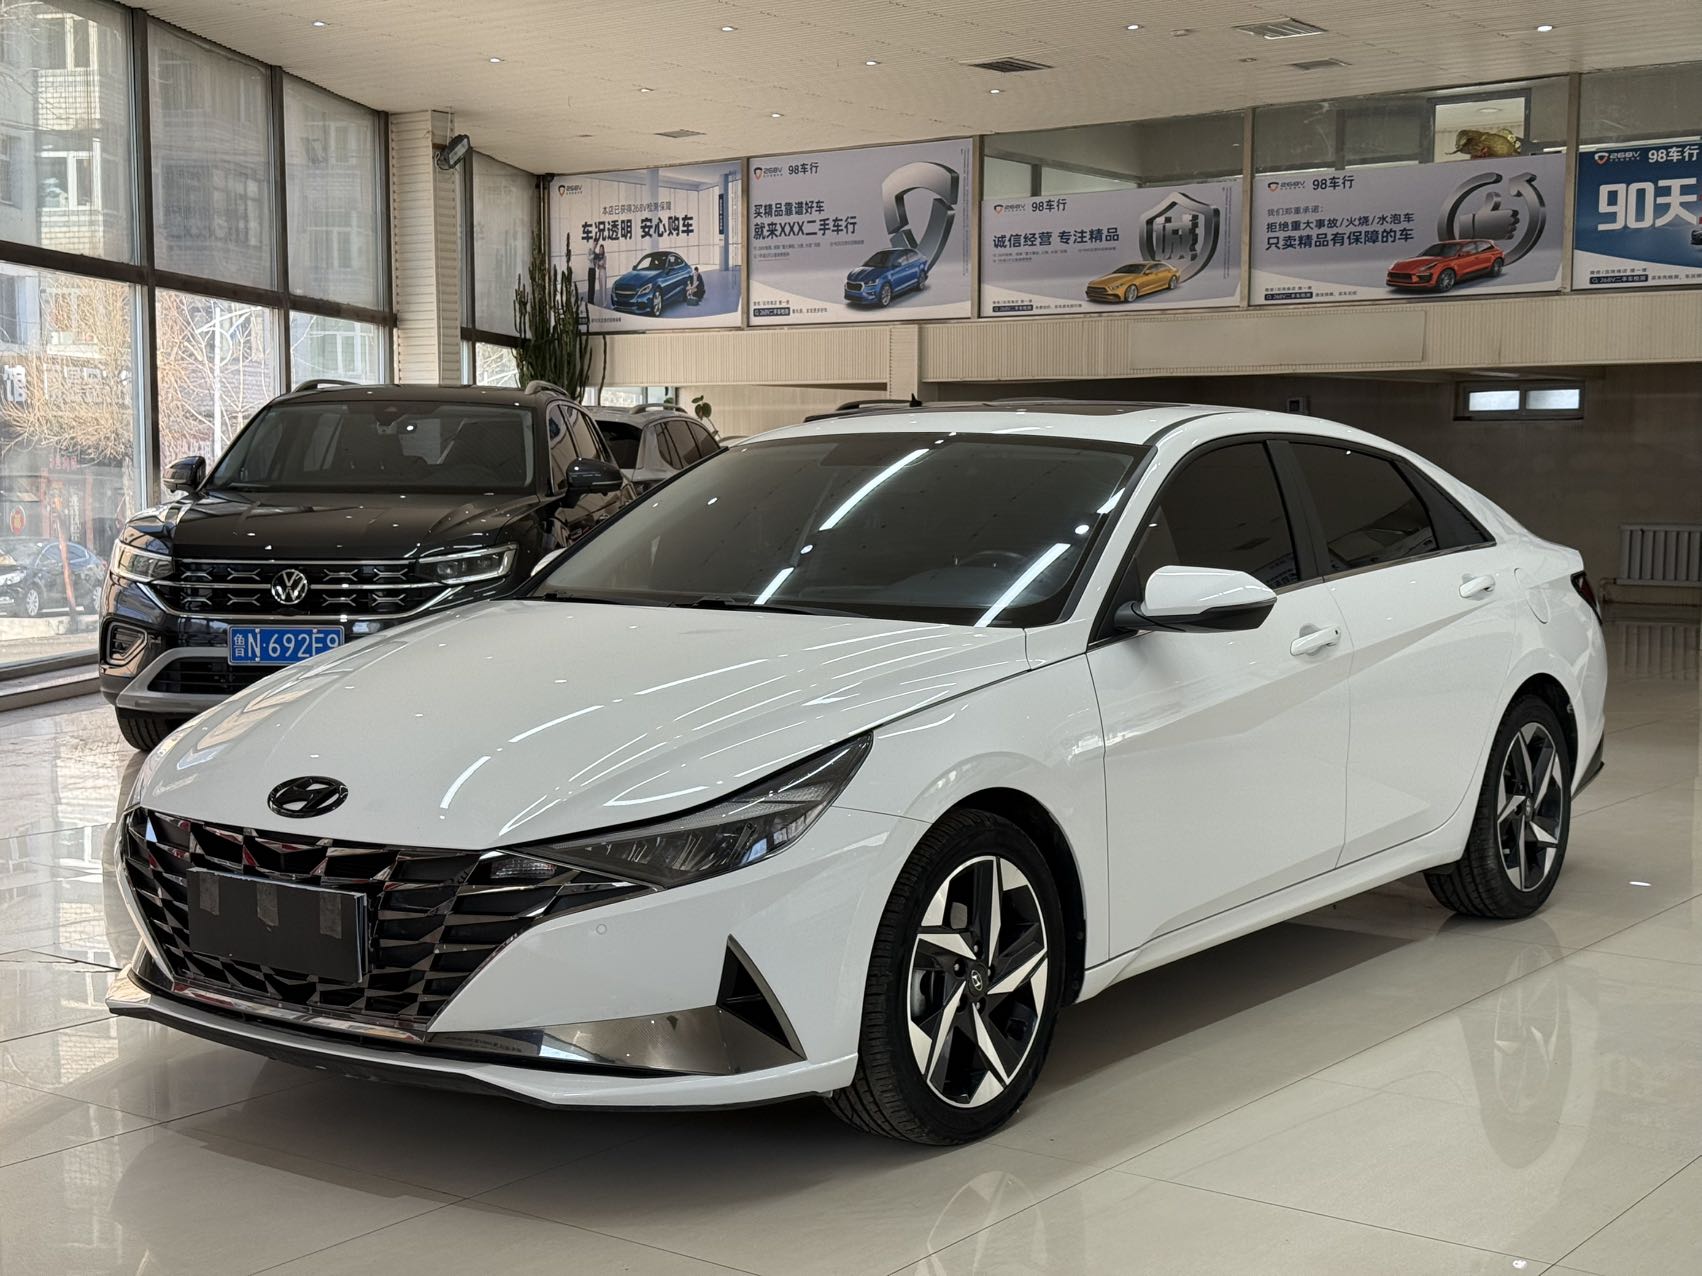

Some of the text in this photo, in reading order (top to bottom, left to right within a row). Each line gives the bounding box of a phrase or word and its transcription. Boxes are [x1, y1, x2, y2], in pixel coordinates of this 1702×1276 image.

[1648, 145, 1700, 164] 98车行
[788, 162, 819, 175] 98车行
[1312, 175, 1355, 191] 98车行
[753, 200, 825, 219] 买精品靠谱好车
[1031, 199, 1067, 213] 98车行
[1597, 177, 1702, 232] 90天
[581, 221, 633, 243] 车况透明
[640, 214, 694, 239] 安心购车
[753, 216, 857, 240] 就来XXX二手车行
[1266, 212, 1415, 233] 拒绝重大事故/火烧/水泡车
[993, 227, 1120, 249] 诚信经营 专注精品
[1265, 227, 1415, 251] 只卖精品有保障的车
